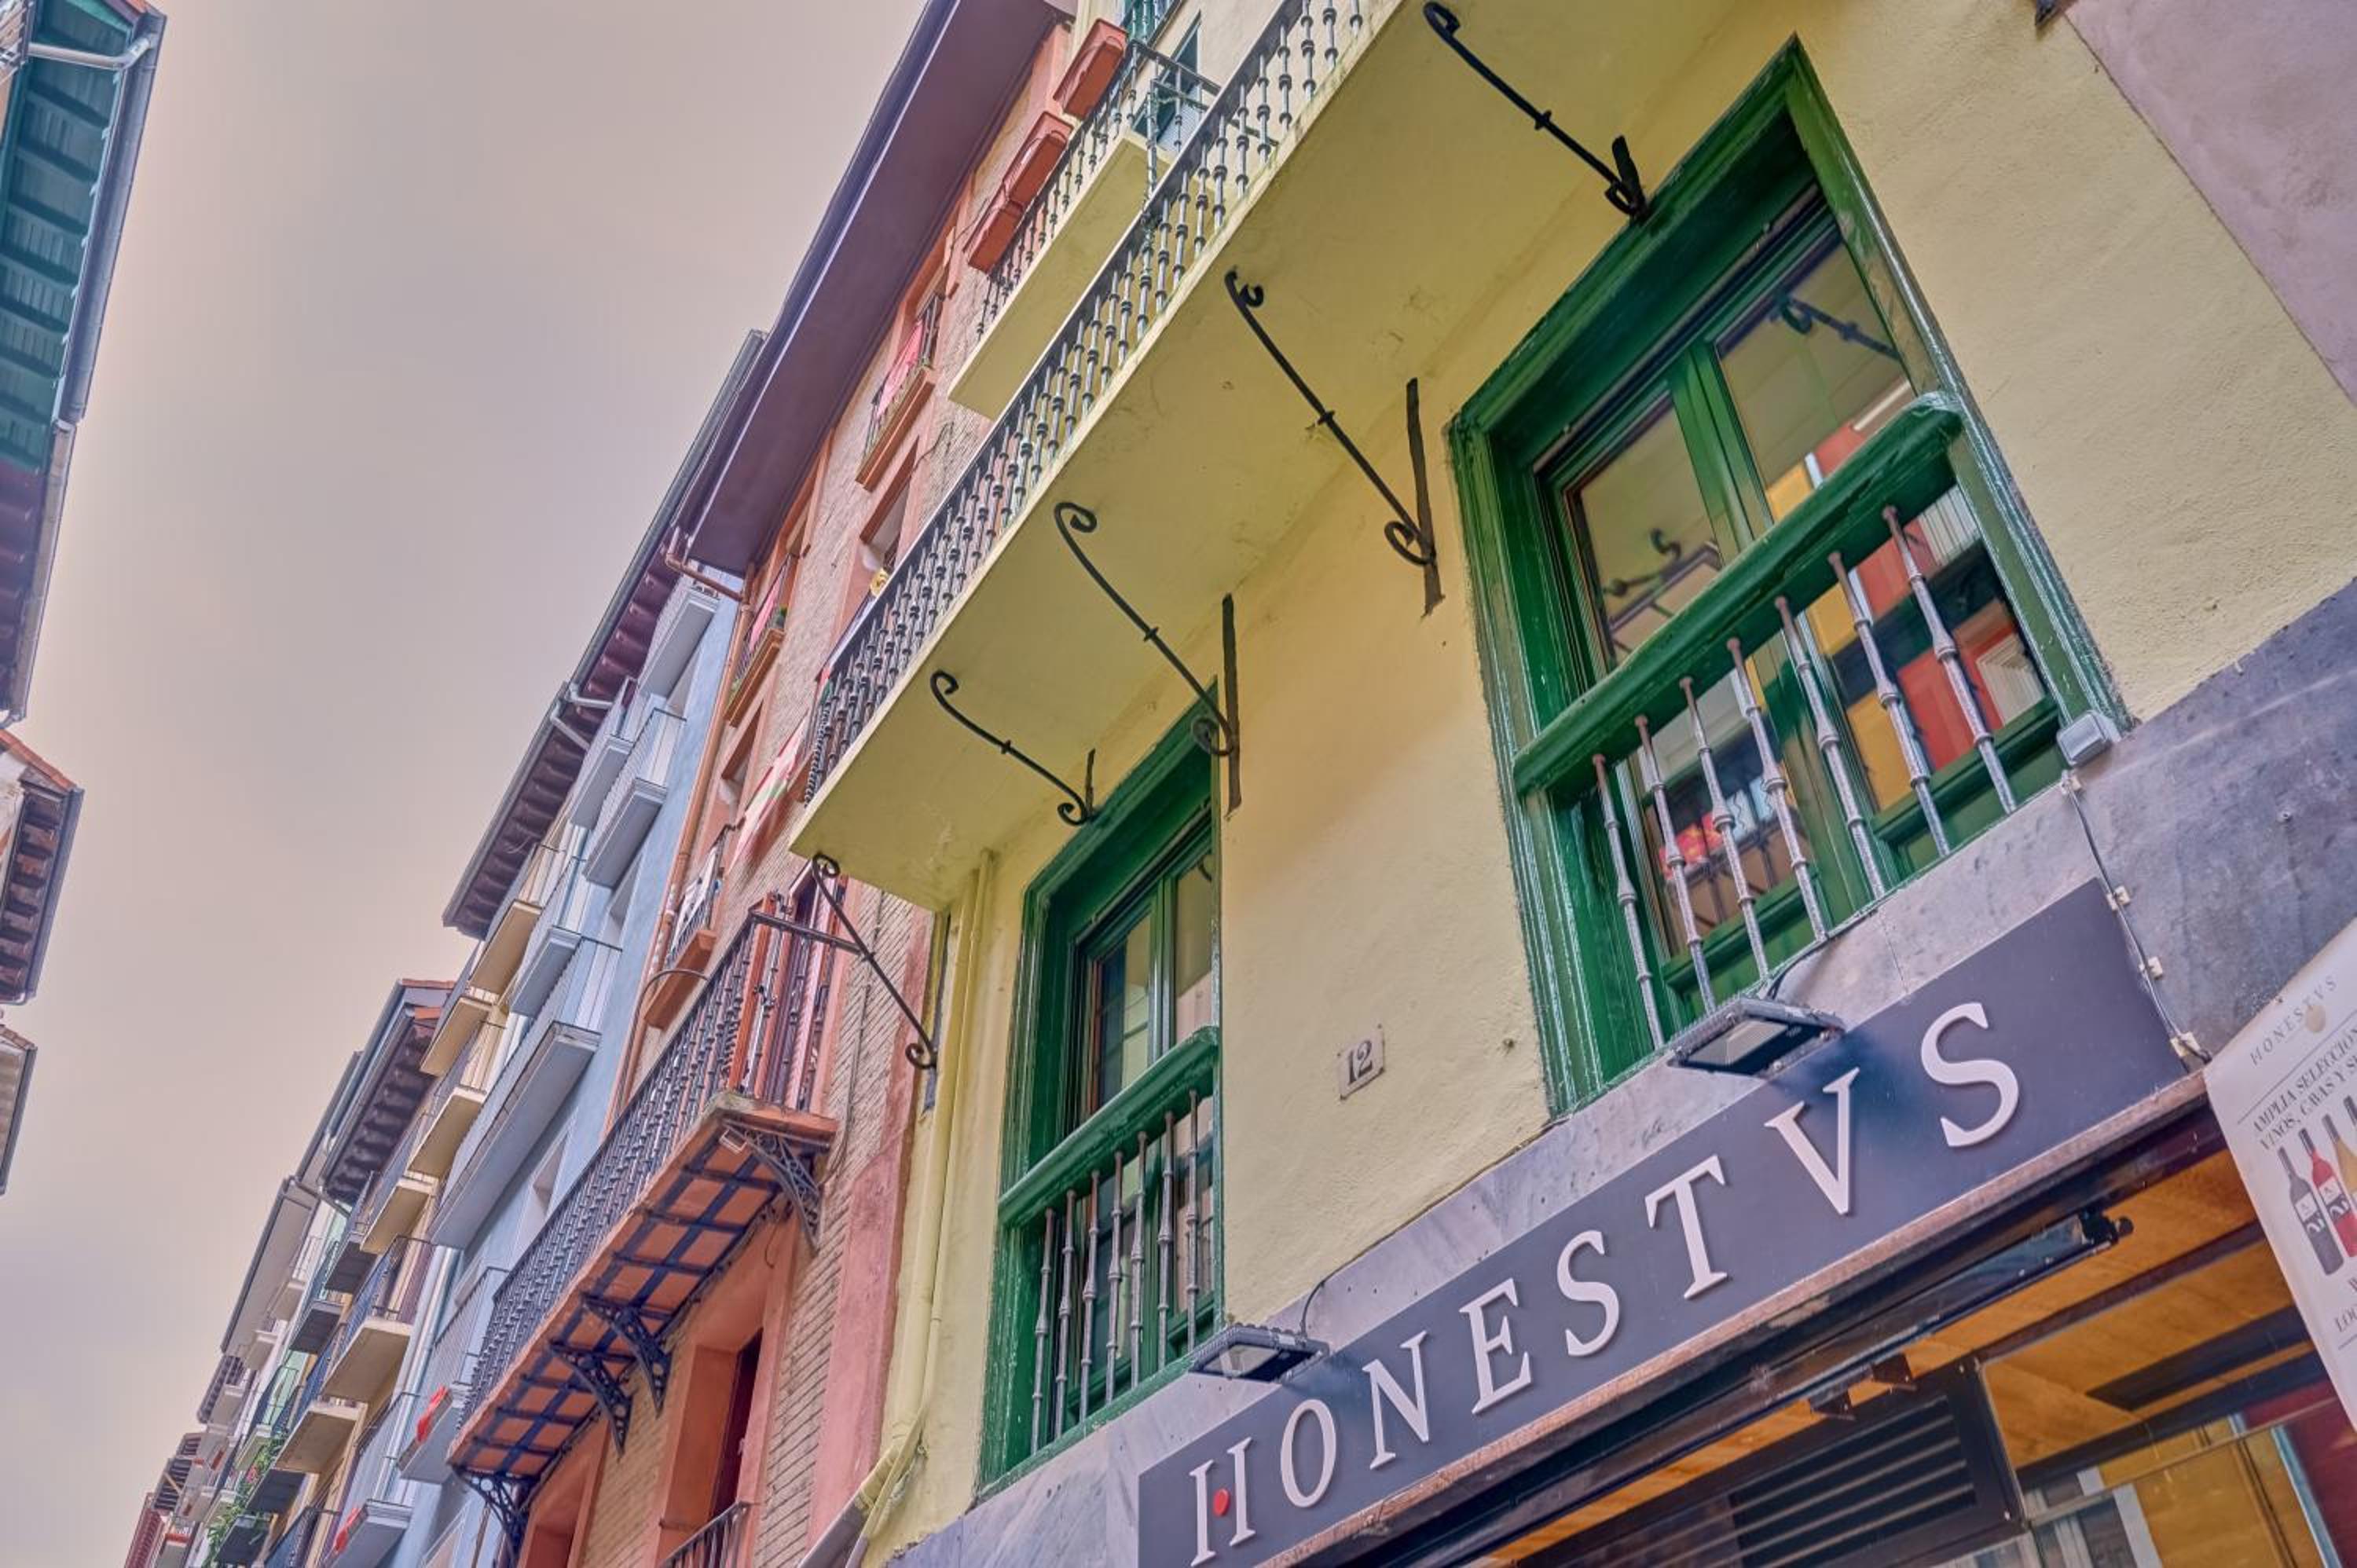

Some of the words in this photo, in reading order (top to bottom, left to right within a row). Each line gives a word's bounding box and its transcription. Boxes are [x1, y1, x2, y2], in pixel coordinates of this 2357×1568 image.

[1347, 1039, 1373, 1085] 12
[2253, 1089, 2297, 1132] AMPLIA
[1189, 1002, 2022, 1567] HONESTVS
